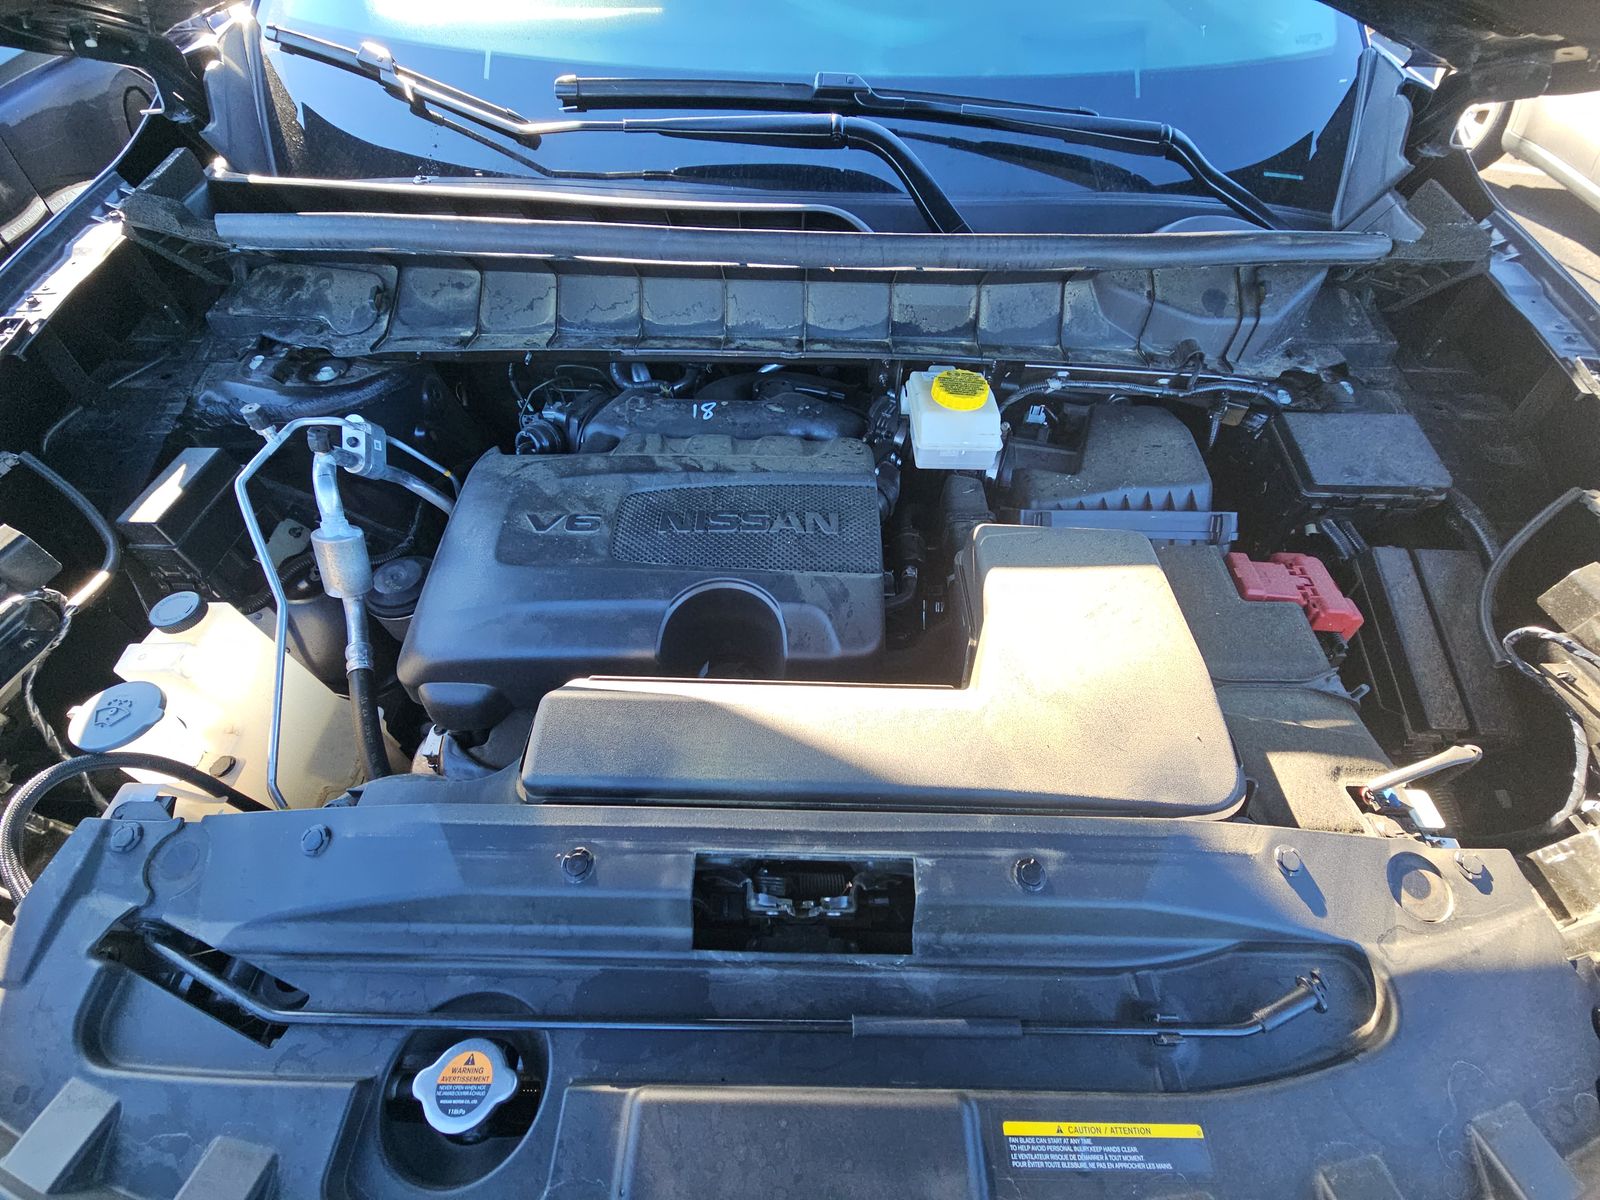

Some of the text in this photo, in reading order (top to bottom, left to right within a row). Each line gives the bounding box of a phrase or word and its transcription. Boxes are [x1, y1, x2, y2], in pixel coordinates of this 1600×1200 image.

[692, 401, 716, 420] 18
[525, 513, 602, 533] V6
[658, 510, 840, 535] NISSAN
[452, 1066, 484, 1074] WARNING
[1068, 1126, 1102, 1134] CAUTION
[1110, 1126, 1152, 1135] ATTENTION
